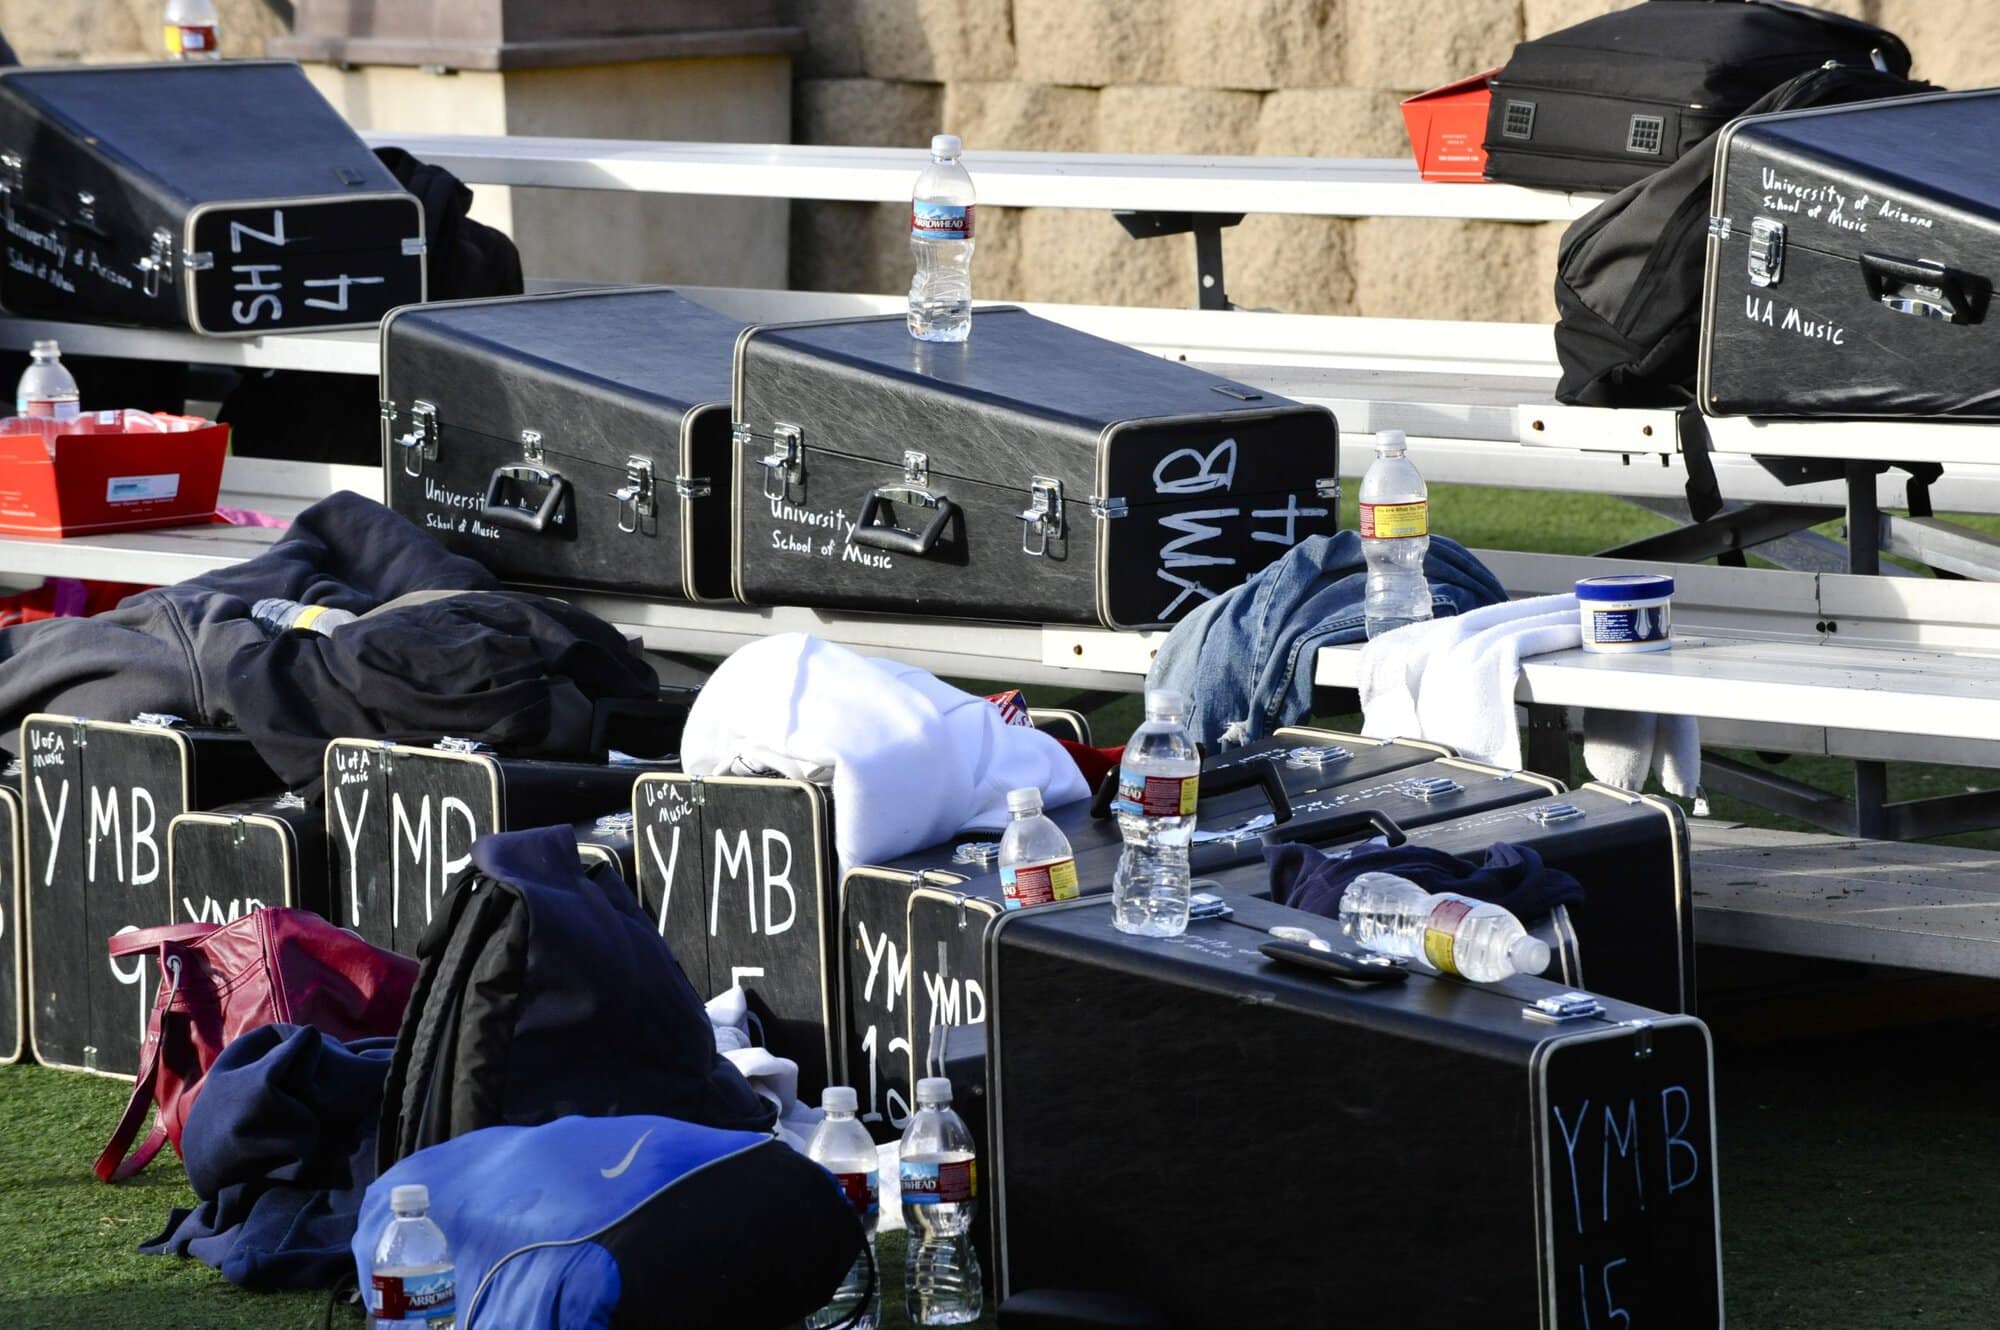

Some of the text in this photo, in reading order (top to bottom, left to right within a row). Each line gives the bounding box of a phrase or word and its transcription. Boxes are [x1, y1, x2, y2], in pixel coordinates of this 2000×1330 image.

[1762, 167, 1933, 228] University of Arizona
[1763, 195, 1868, 233] School of Music
[231, 210, 285, 325] SHZ
[304, 274, 385, 311] 4
[1746, 294, 1844, 345] UA Music
[425, 477, 487, 512] Universit
[771, 493, 857, 544] University
[426, 512, 454, 531] School
[471, 520, 500, 539] Music
[772, 529, 893, 569] School of Music
[1152, 438, 1241, 621] YMB
[35, 775, 160, 886] YMB
[646, 824, 796, 937] YMB
[858, 921, 911, 1013] YM
[1553, 1086, 1699, 1234] YMB
[1579, 1258, 1631, 1330] 15
